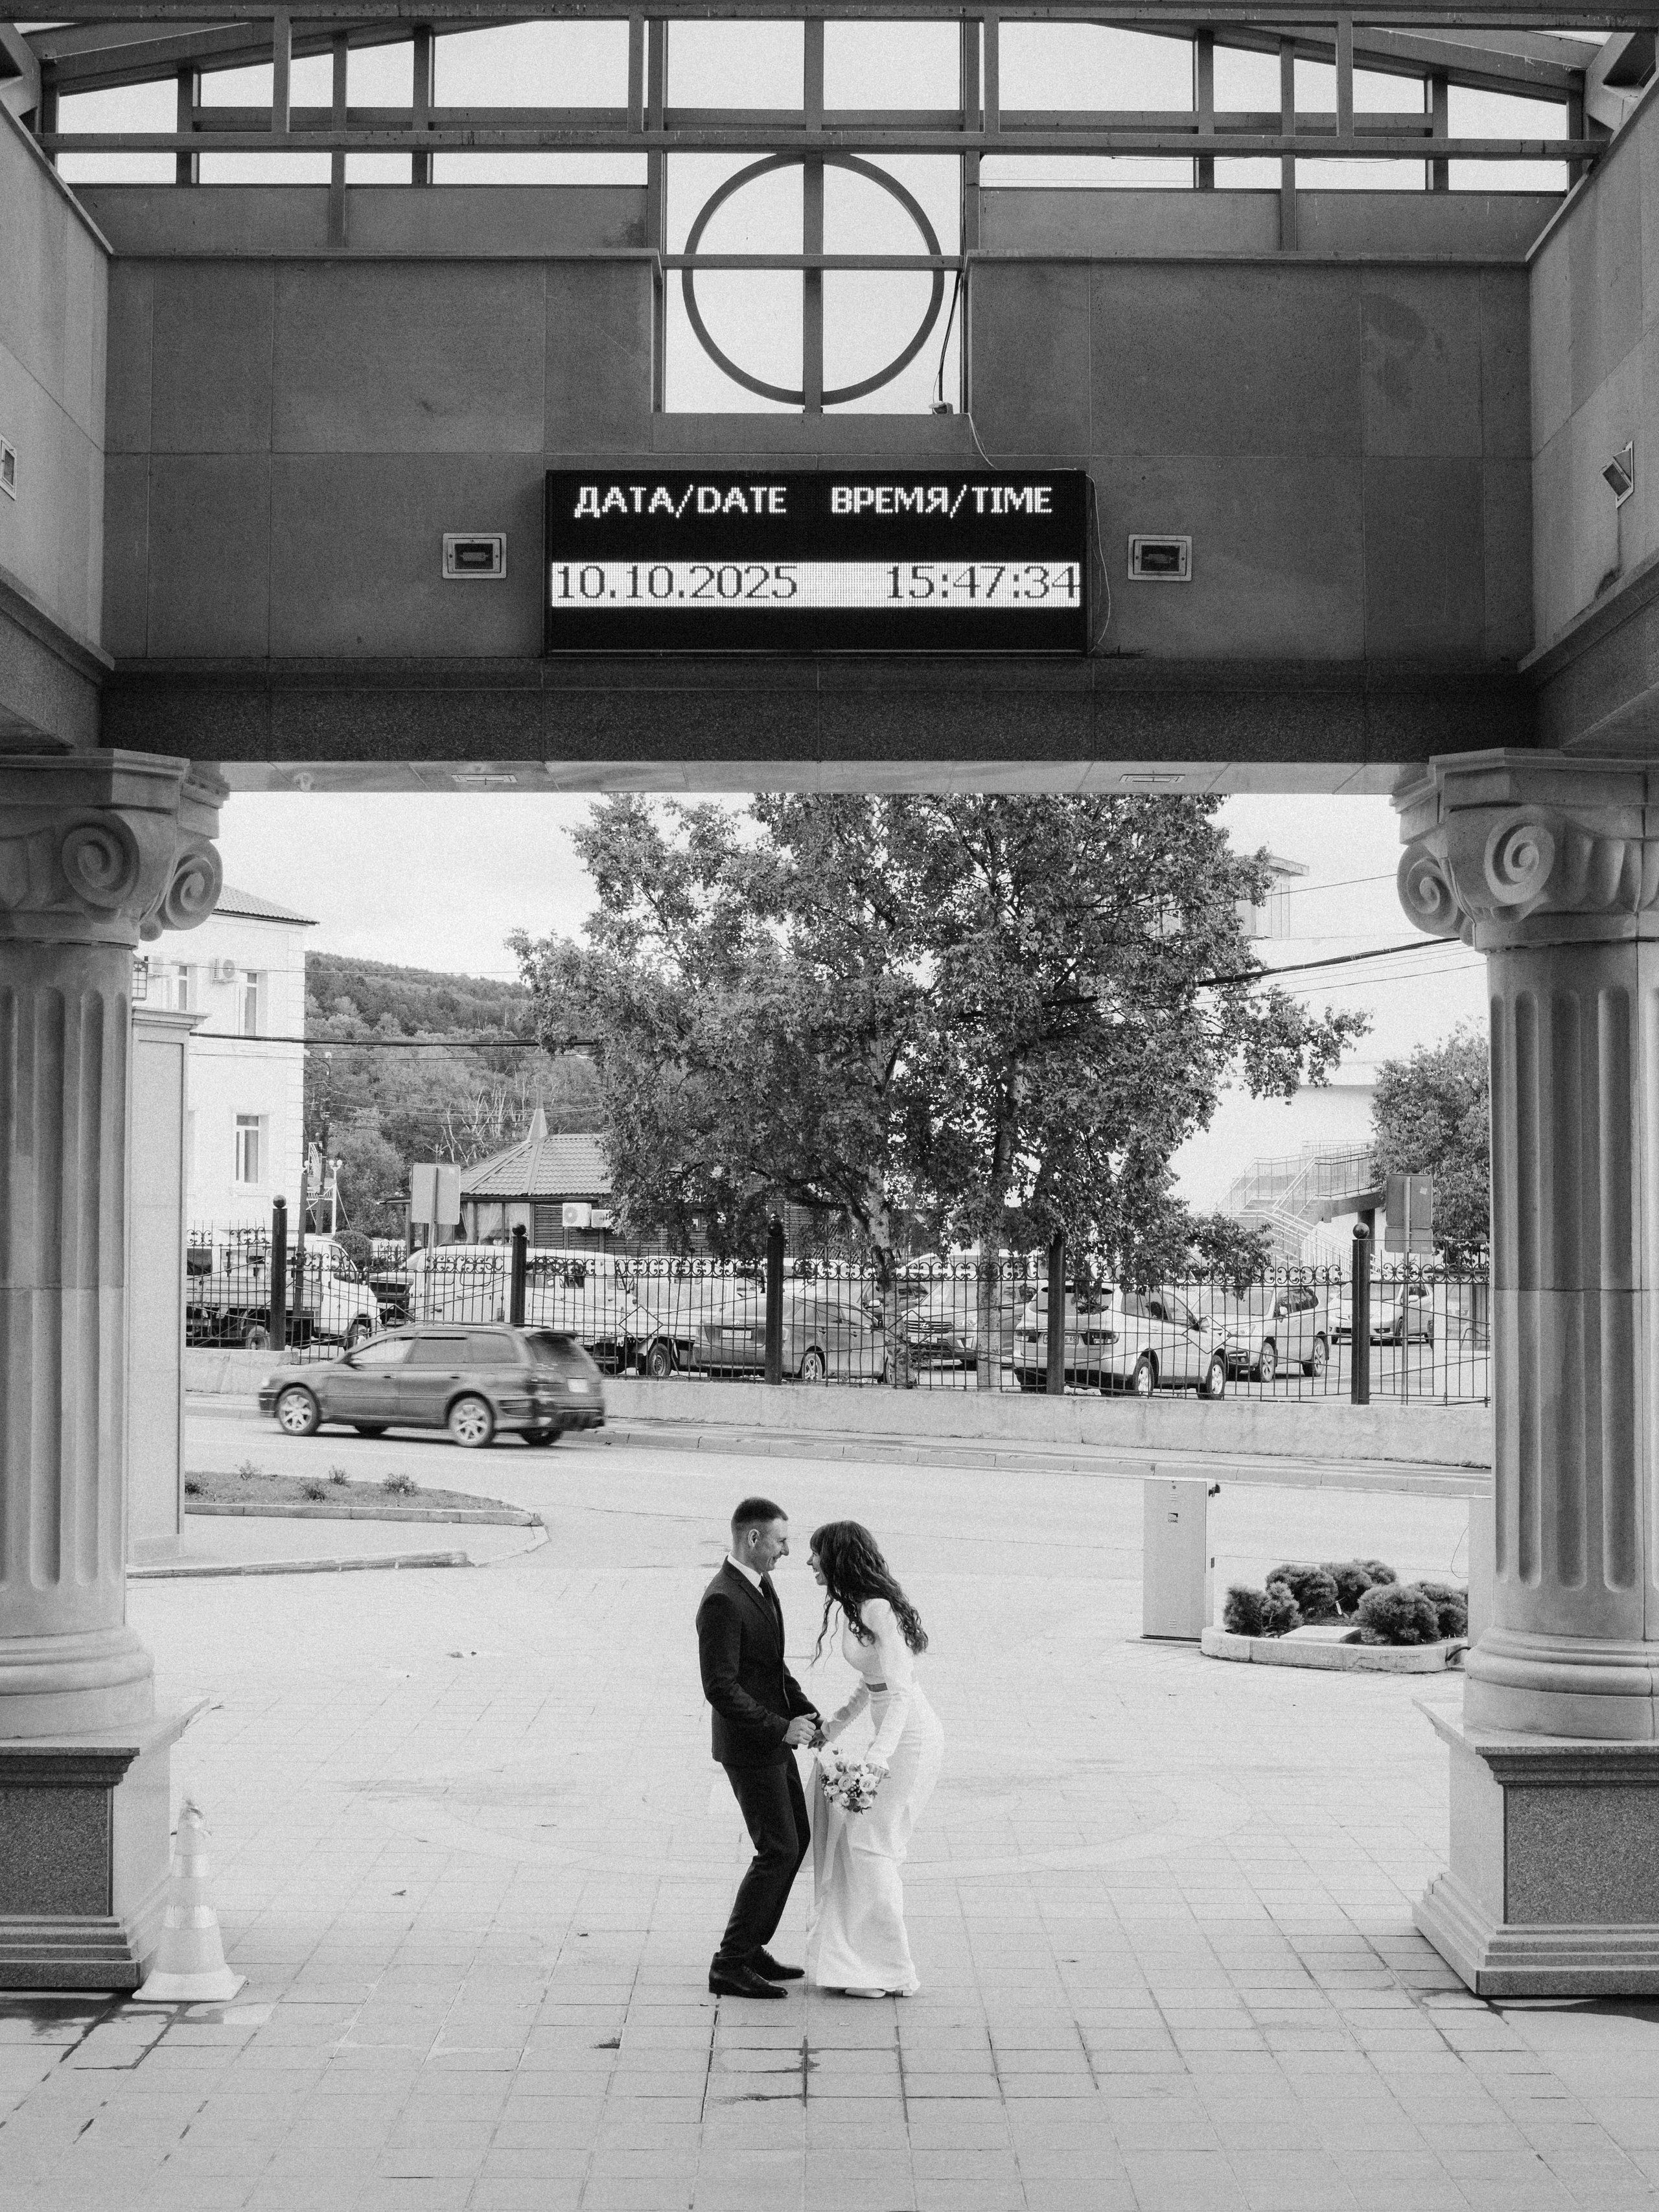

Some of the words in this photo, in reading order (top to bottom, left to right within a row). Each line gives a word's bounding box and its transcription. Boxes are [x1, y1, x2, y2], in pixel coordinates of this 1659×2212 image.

[574, 484, 787, 518] ДАТА/DATE
[831, 484, 1052, 518] ВРЕМЯ/TIME
[557, 565, 797, 598] 10.10.2025
[887, 565, 1080, 598] 15:47:34
